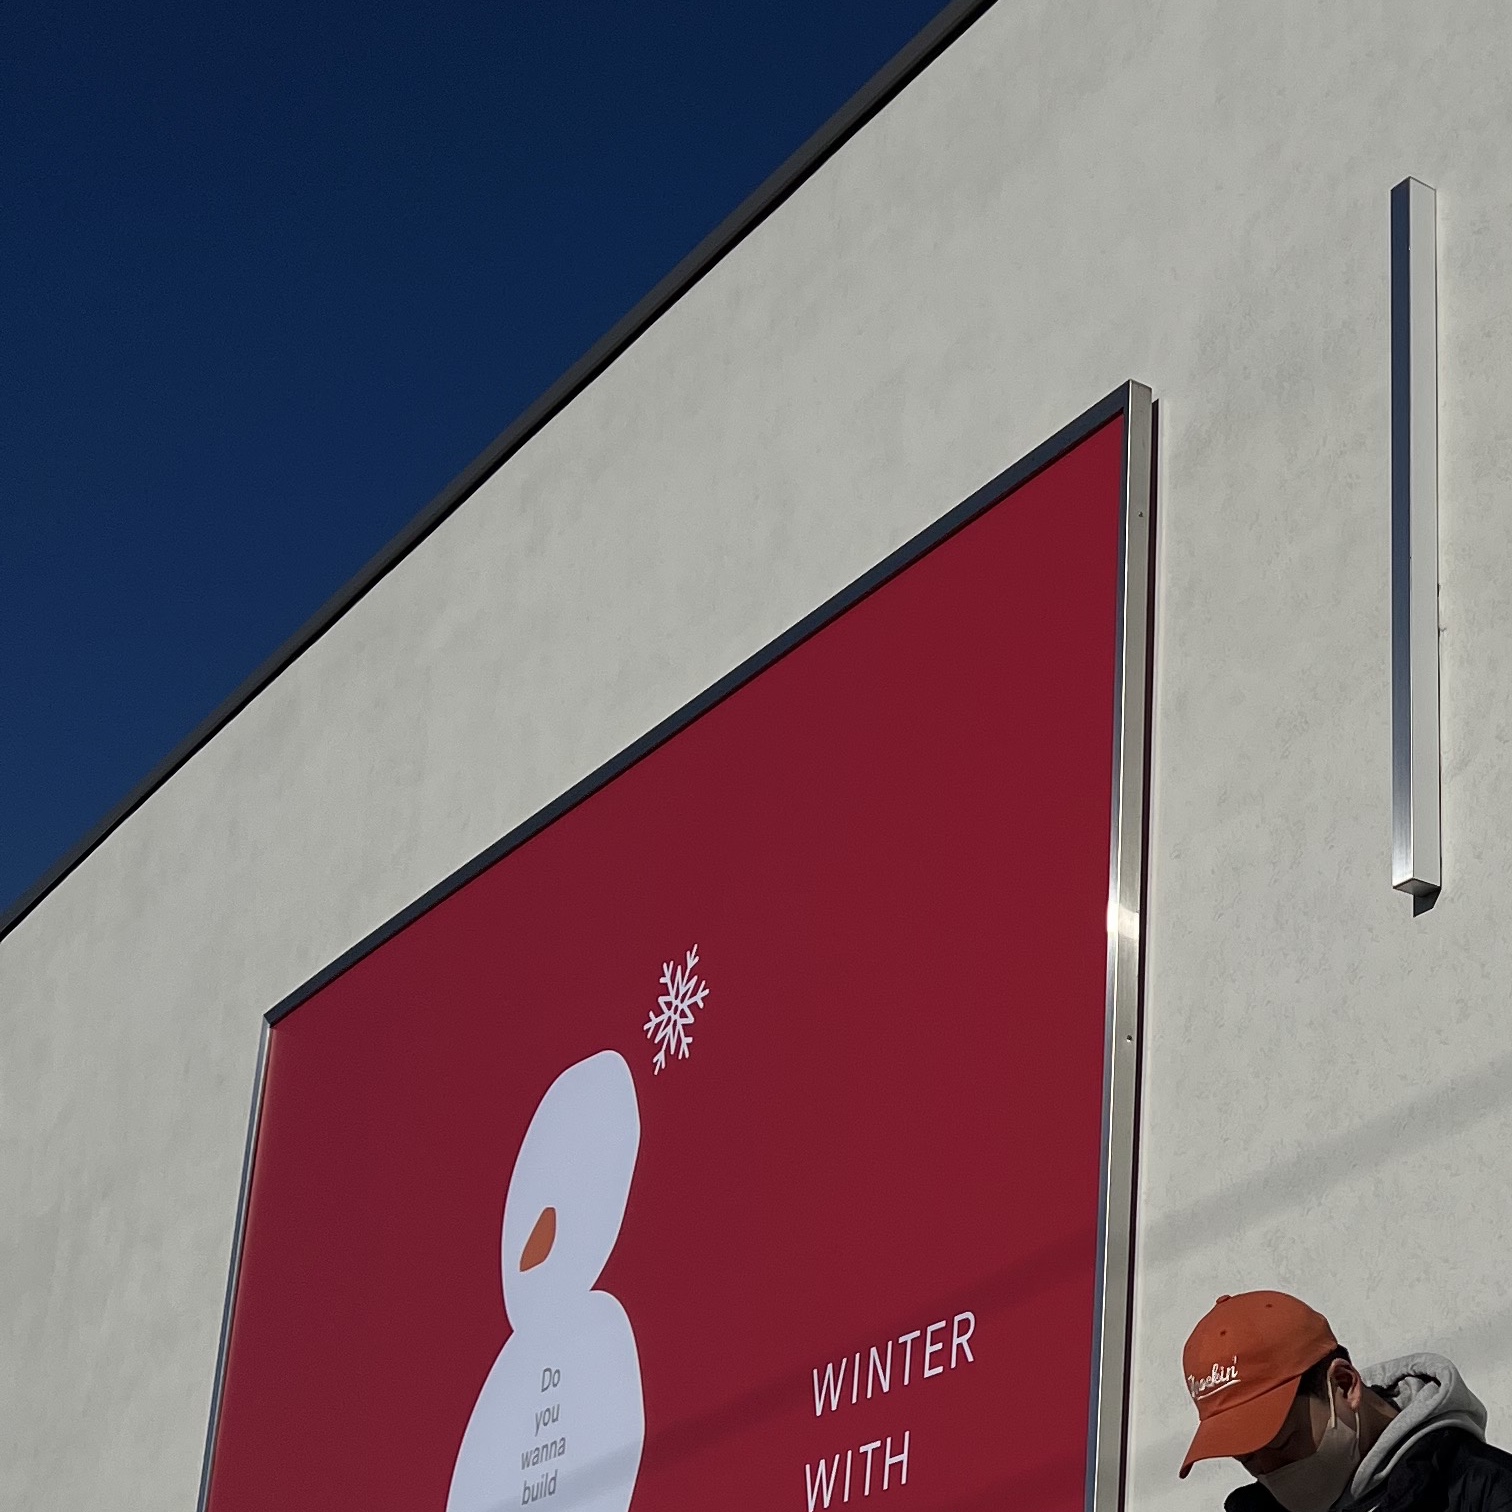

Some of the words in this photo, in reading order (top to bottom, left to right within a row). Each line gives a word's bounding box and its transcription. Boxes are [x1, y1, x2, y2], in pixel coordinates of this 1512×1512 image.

[540, 1366, 561, 1393] Do
[812, 1310, 976, 1417] WINTER
[534, 1403, 561, 1437] you
[520, 1436, 567, 1471] wanna
[521, 1468, 559, 1506] build
